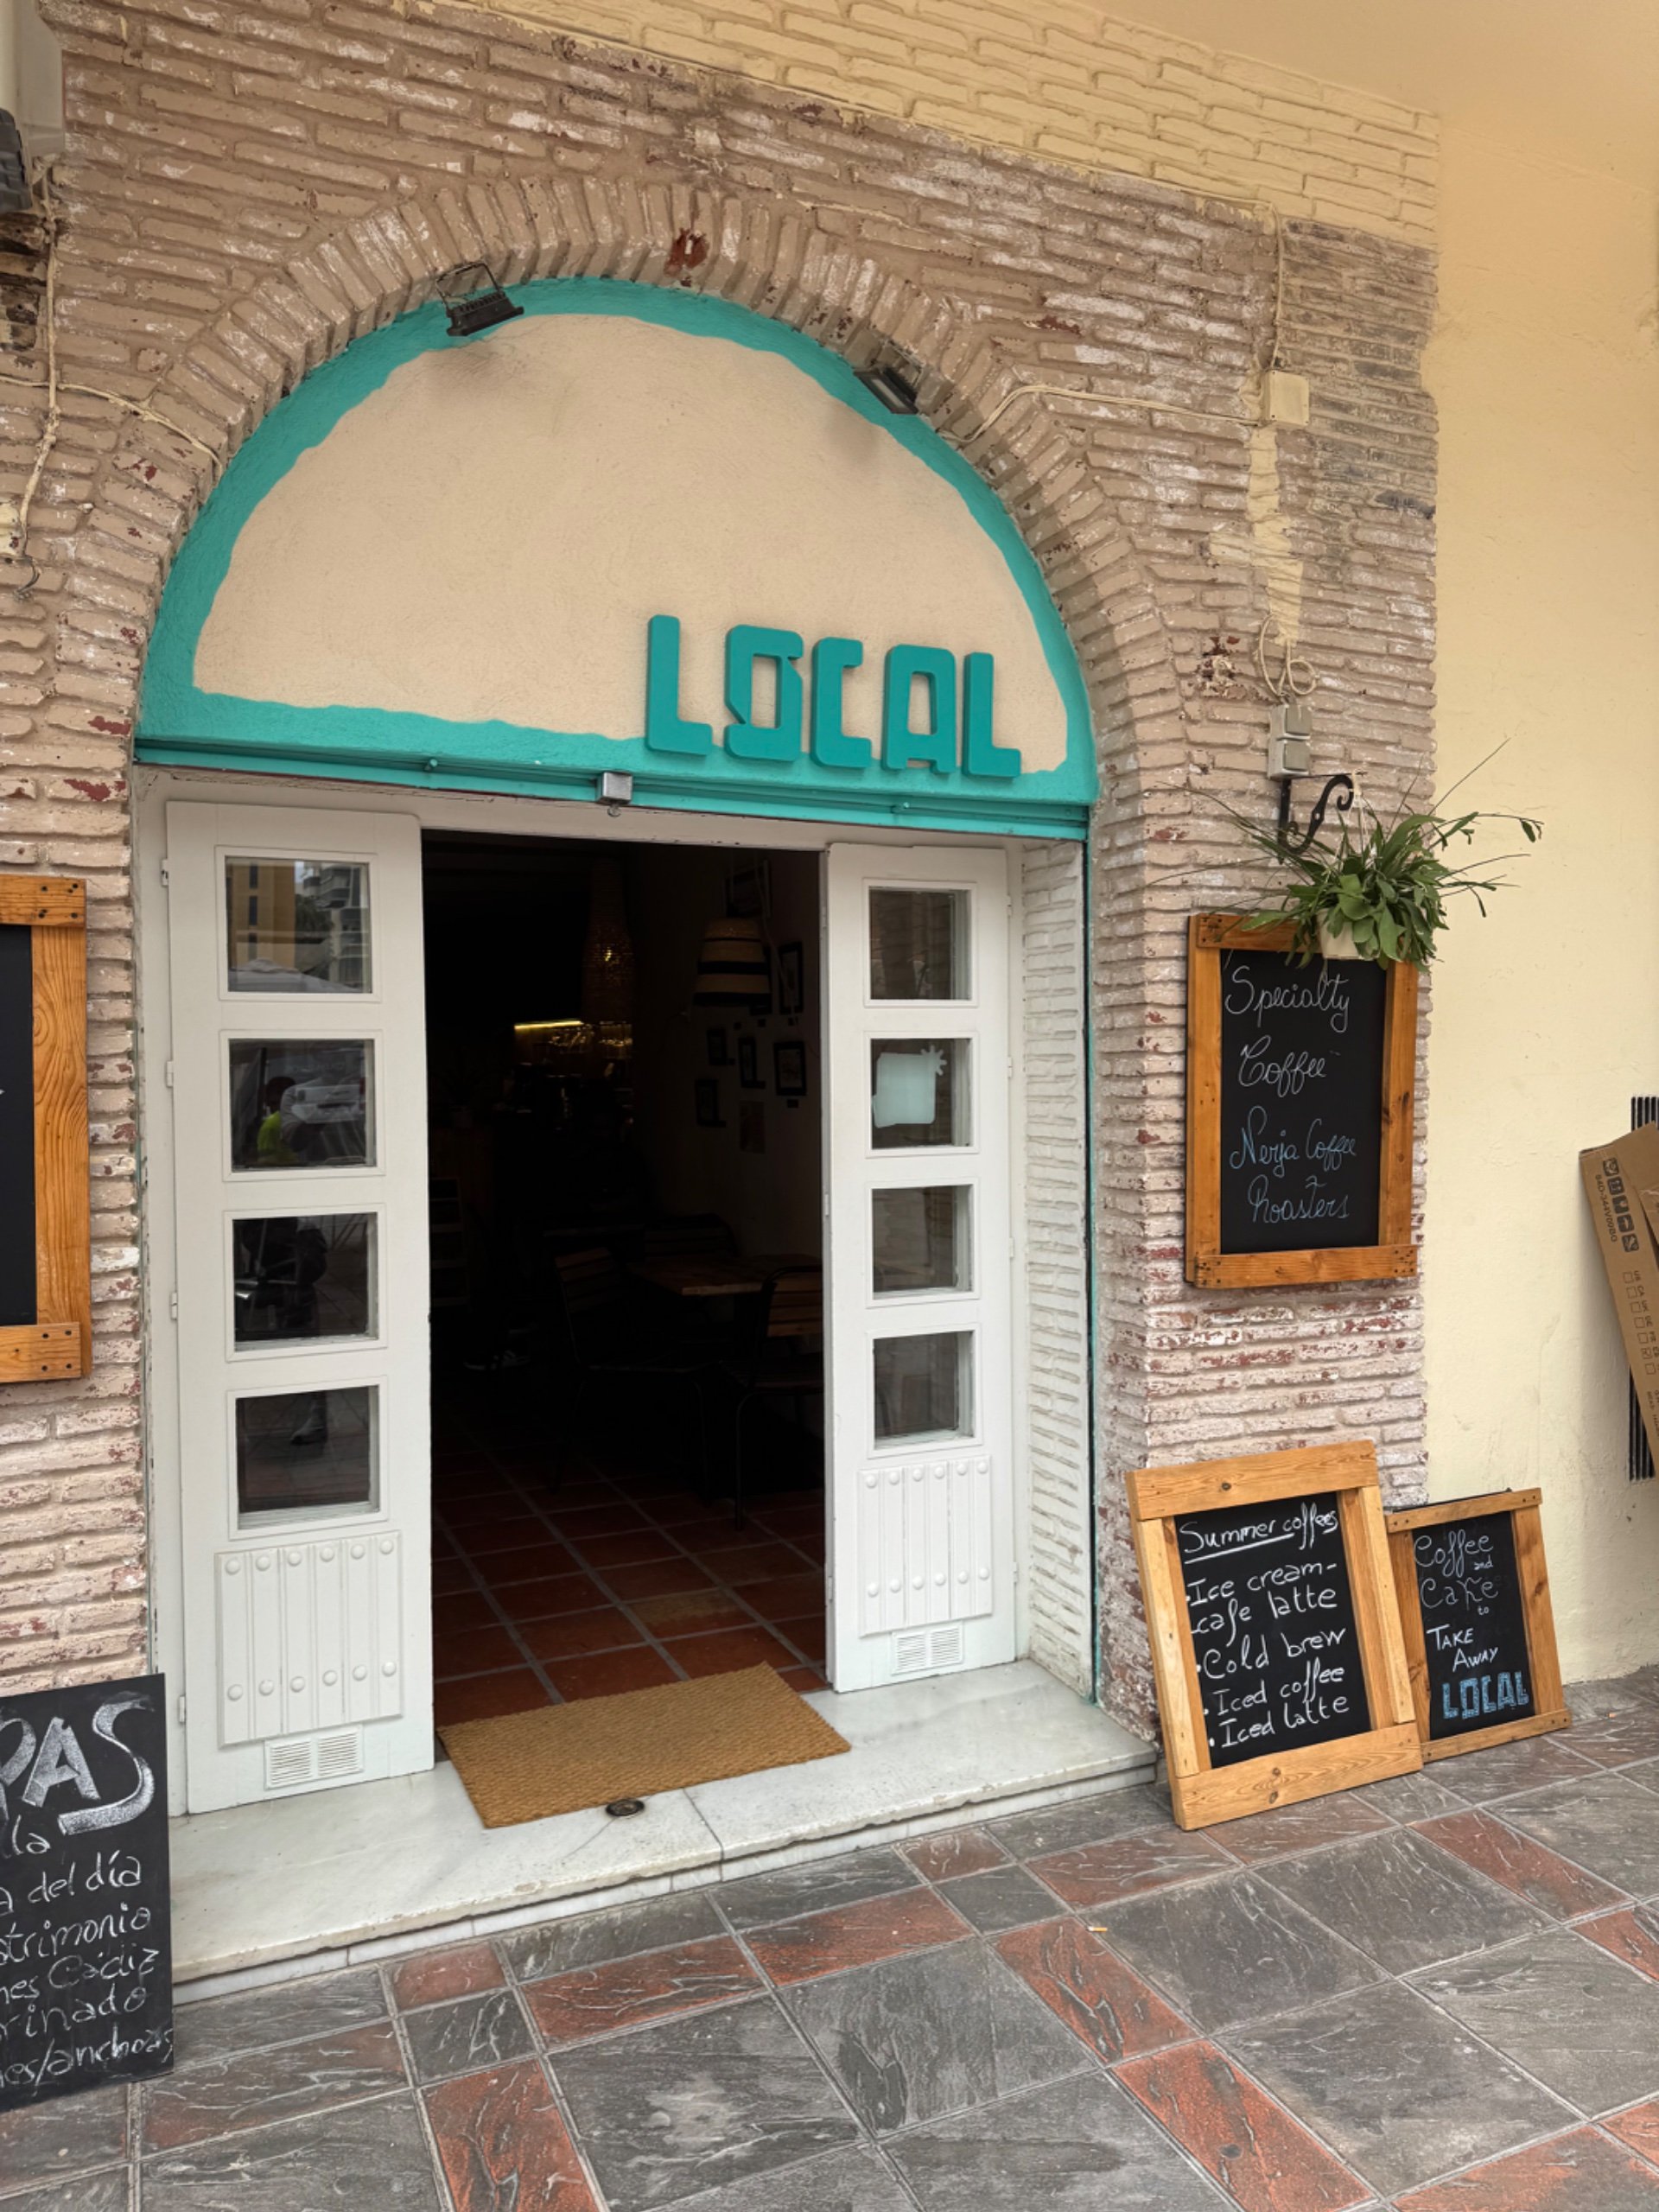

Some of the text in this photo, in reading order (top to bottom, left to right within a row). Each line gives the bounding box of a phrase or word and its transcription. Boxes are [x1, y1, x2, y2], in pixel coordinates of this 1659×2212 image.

[645, 614, 1021, 778] LOCAL
[1225, 965, 1350, 1033] Specialty
[1238, 1035, 1326, 1097] Coffee
[1230, 1106, 1357, 1178] Nerja Coffee
[1248, 1174, 1350, 1223] Roasters
[1179, 1502, 1339, 1553] Summer coffees
[1413, 1529, 1494, 1578] Coffee
[1473, 1555, 1493, 1570] and
[1189, 1579, 1235, 1606] Ice
[1191, 1585, 1338, 1647] cafe latte
[1421, 1576, 1498, 1611] Cake
[1478, 1605, 1490, 1616] to
[1203, 1628, 1346, 1679] Cold brew
[1427, 1624, 1474, 1651] TAKE
[1213, 1657, 1345, 1716] Iced coffee
[1441, 1670, 1530, 1719] LOCAL
[1218, 1695, 1350, 1747] Iced latte
[28, 1861, 76, 1904] del
[86, 1850, 142, 1891] día
